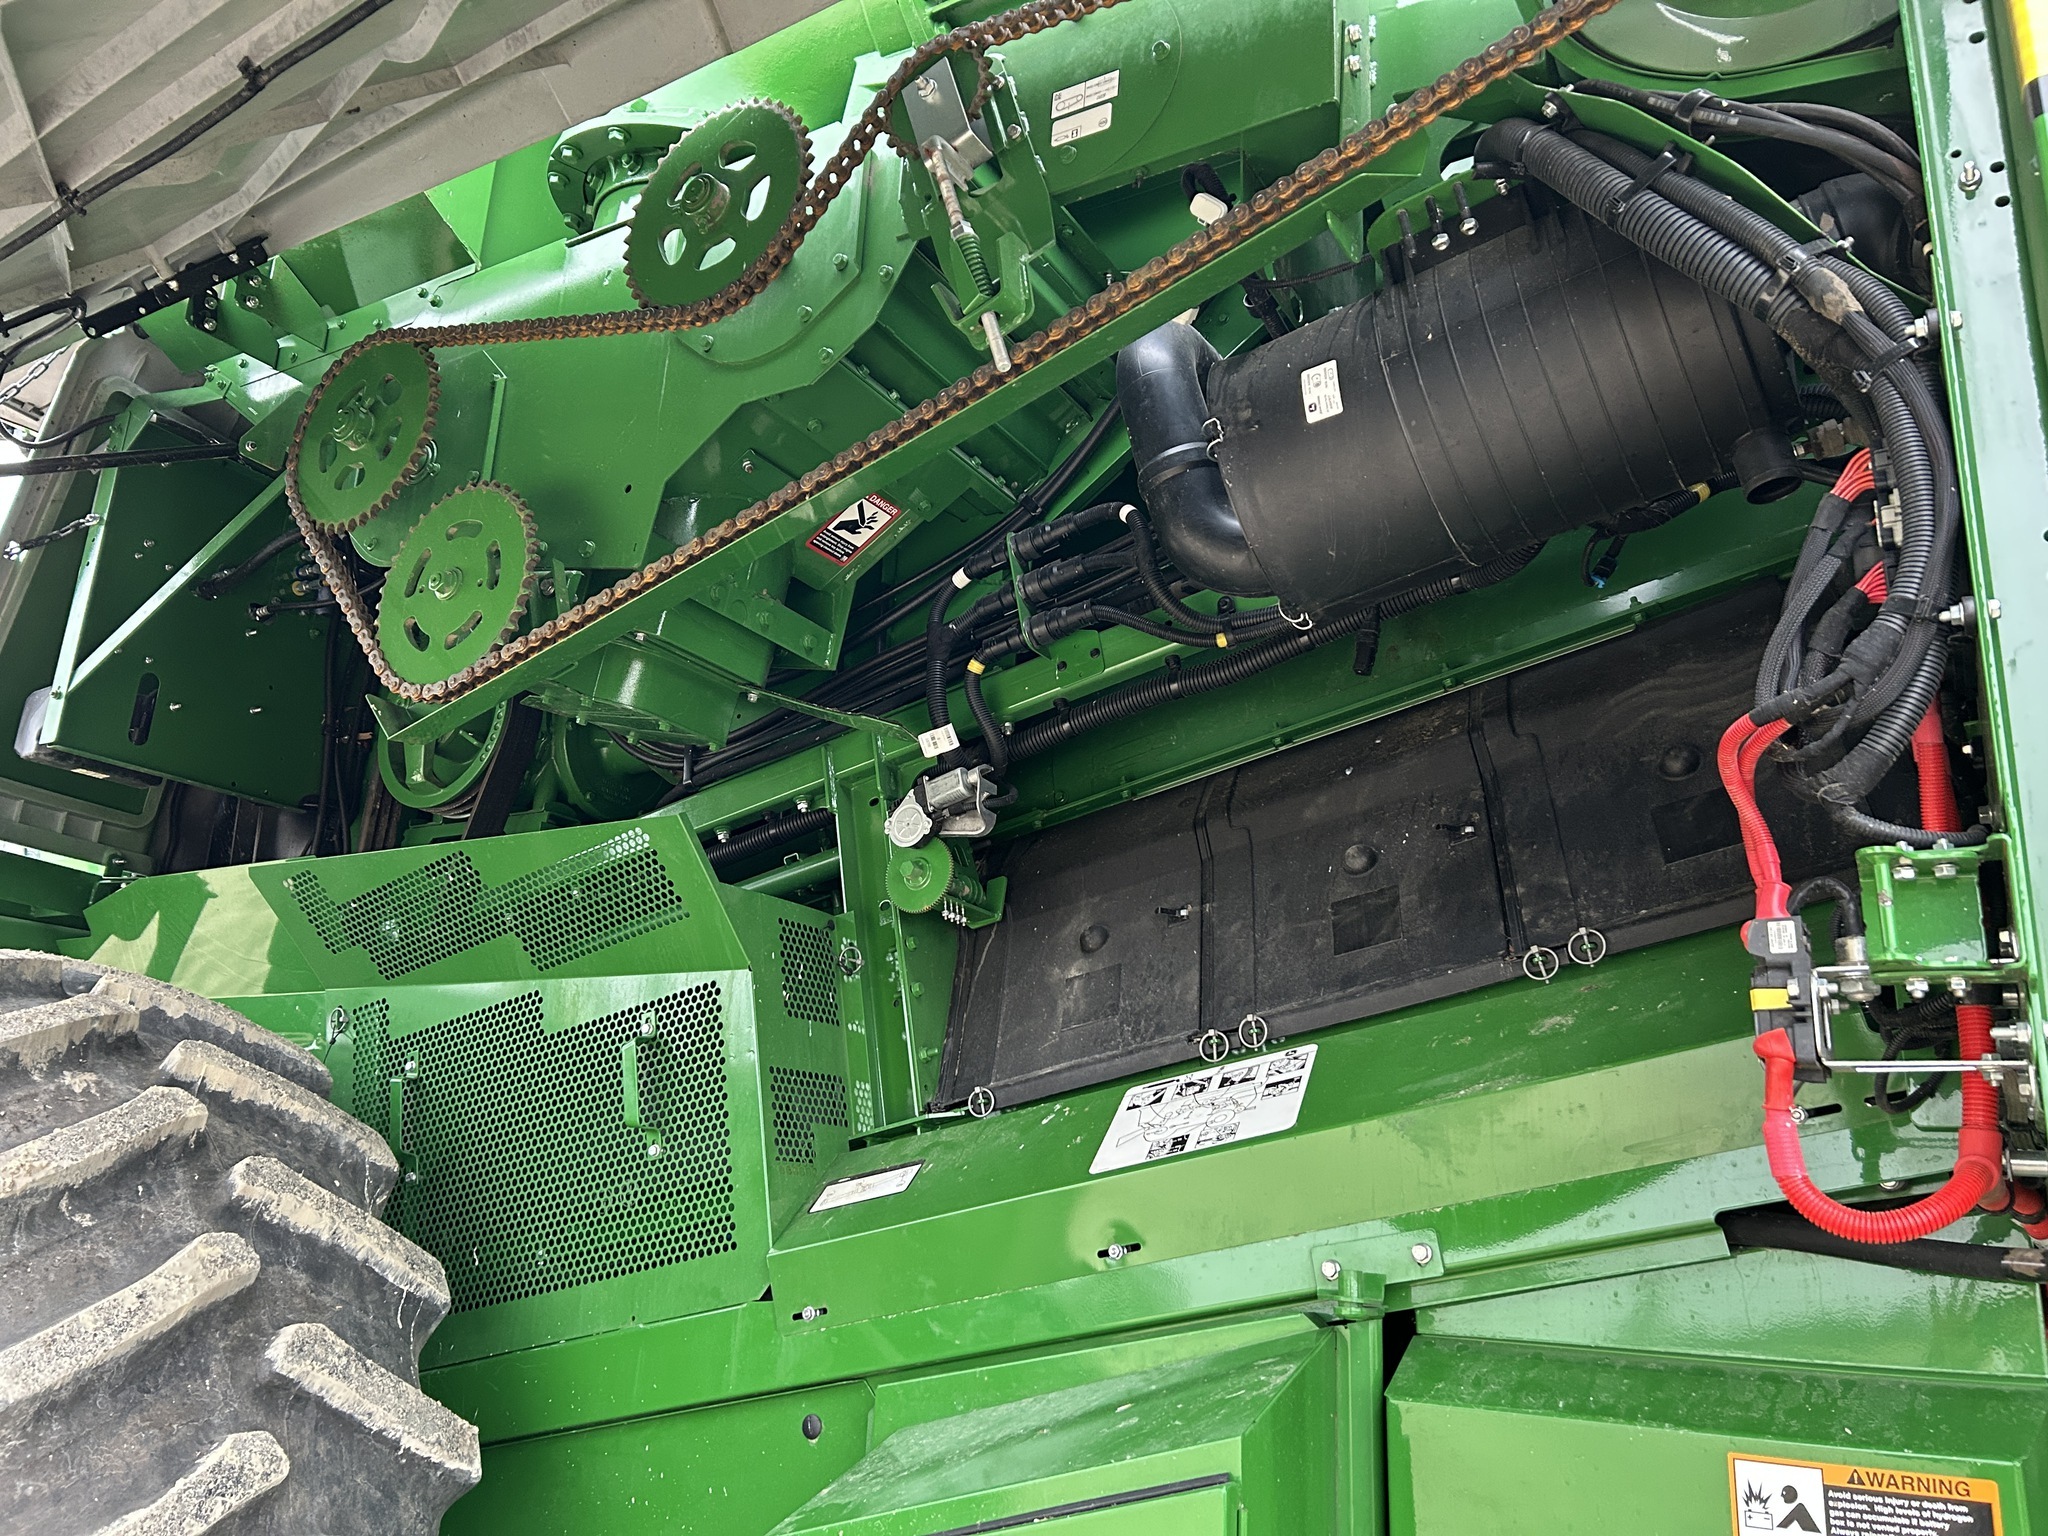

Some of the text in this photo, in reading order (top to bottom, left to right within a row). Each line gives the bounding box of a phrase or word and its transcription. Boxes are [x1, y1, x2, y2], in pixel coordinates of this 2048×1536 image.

[869, 494, 898, 516] DANGER
[1865, 1472, 1970, 1497] WARNING
[1828, 1490, 1851, 1500] Avoid
[1853, 1493, 1883, 1503] serious
[1885, 1496, 1909, 1507] injury
[1828, 1500, 1870, 1511] explosion.
[1874, 1504, 1894, 1514] High
[1932, 1511, 1974, 1523] hydrogen
[1829, 1510, 1844, 1518] gas
[1846, 1511, 1861, 1519] can
[1830, 1518, 1845, 1526] box
[1856, 1522, 1870, 1530] not
